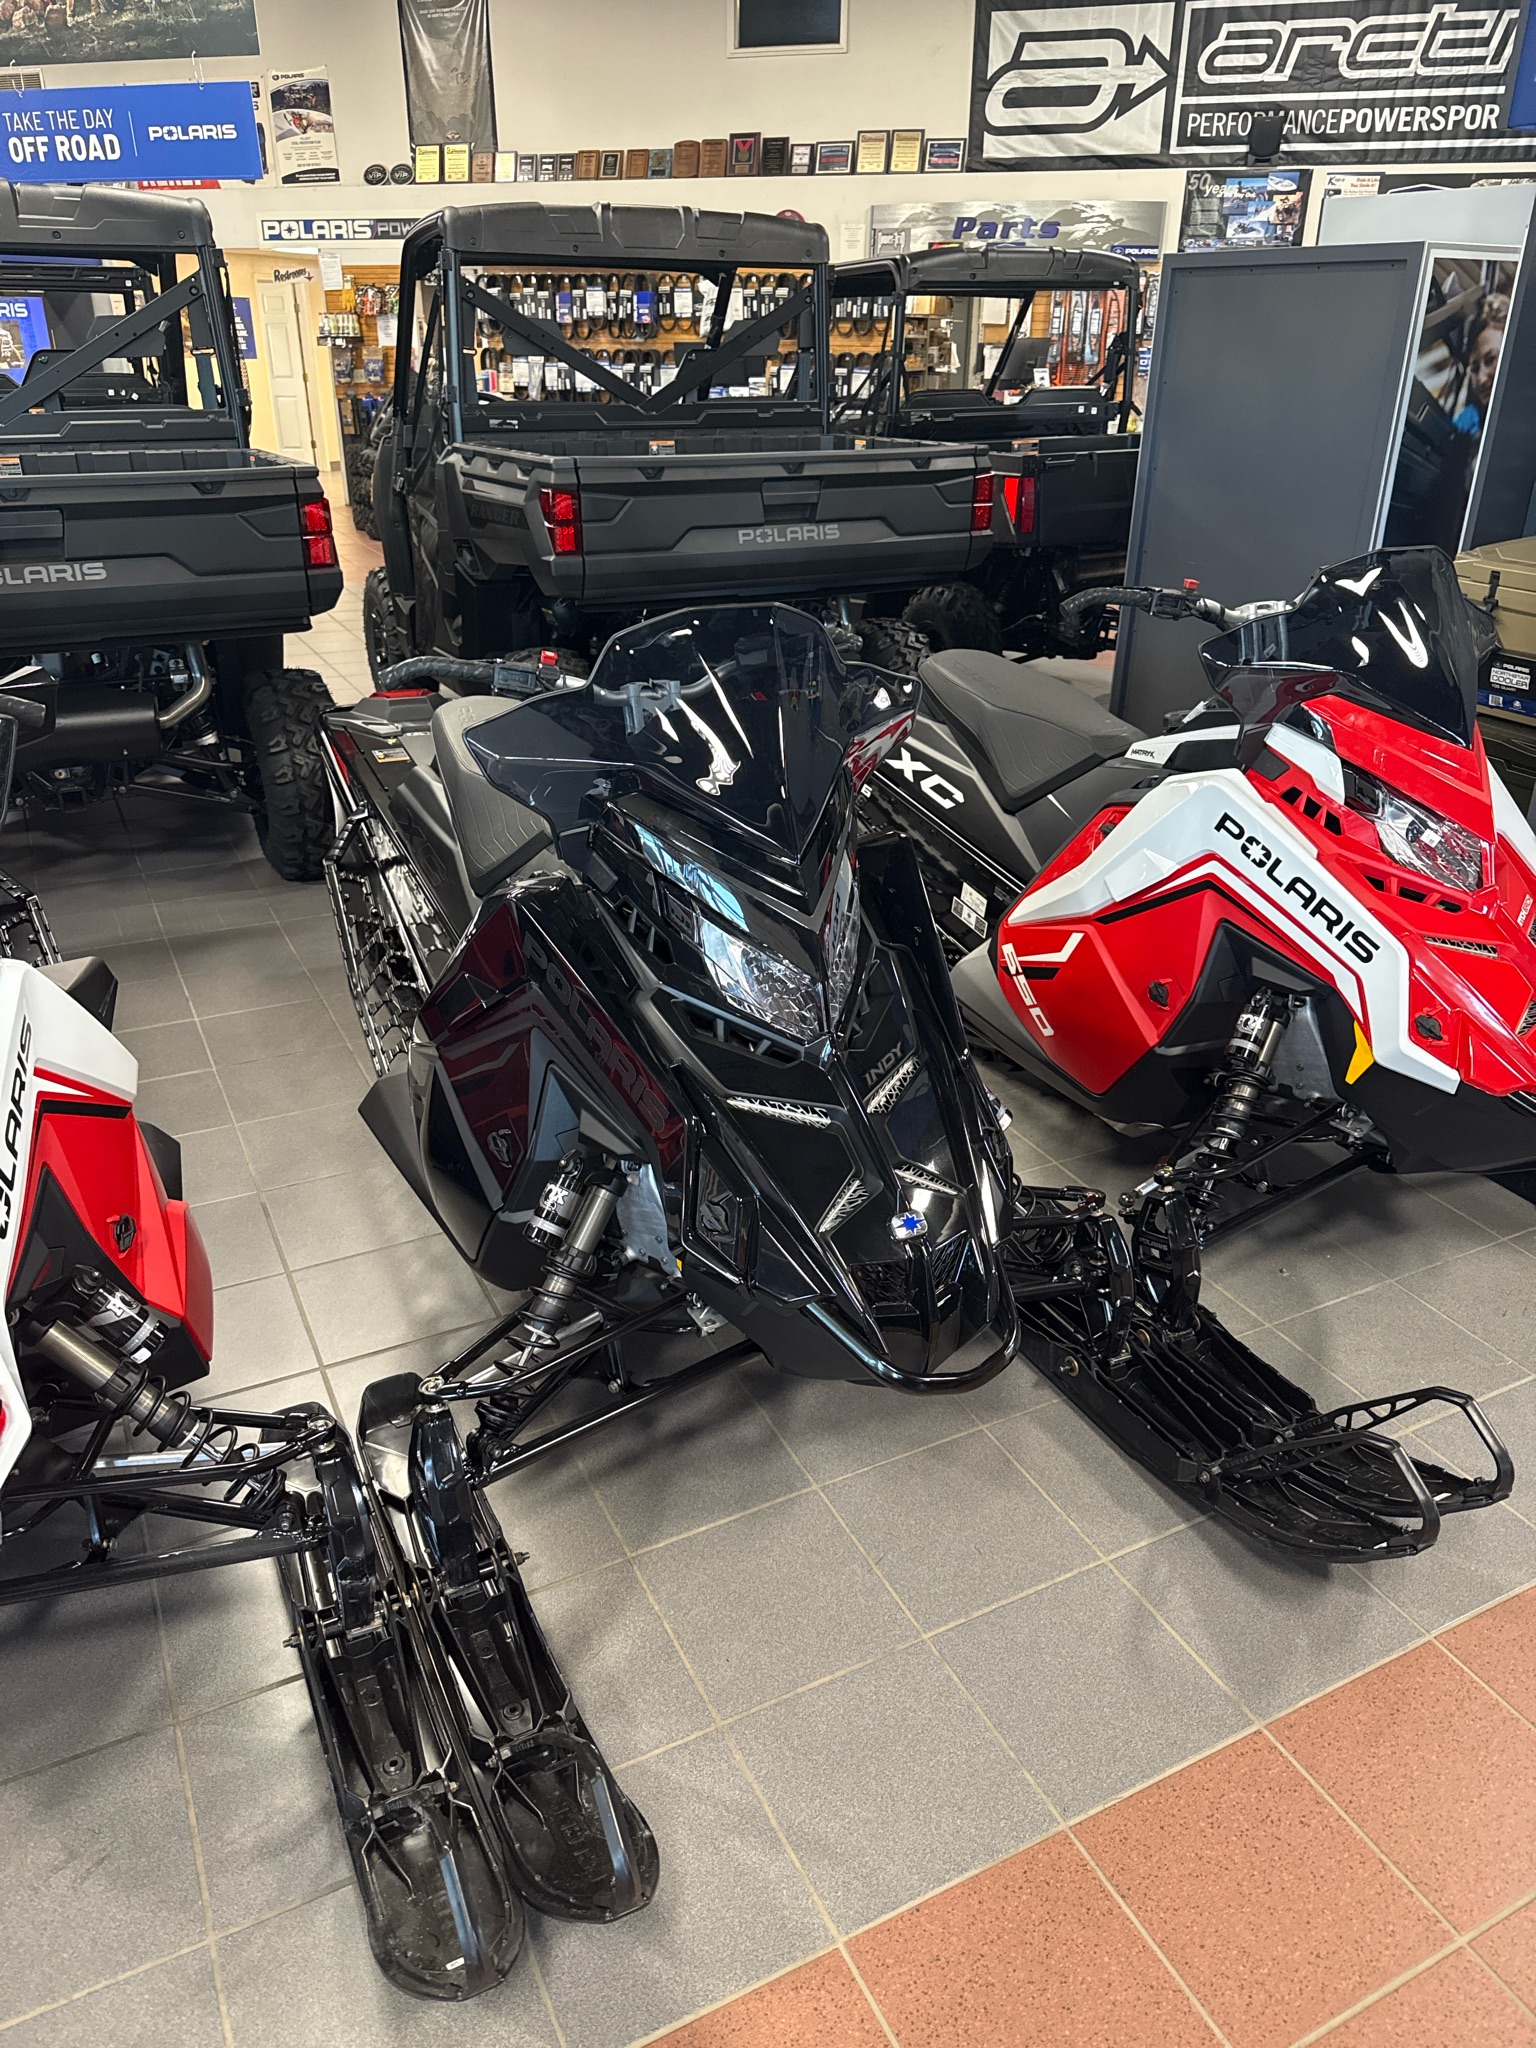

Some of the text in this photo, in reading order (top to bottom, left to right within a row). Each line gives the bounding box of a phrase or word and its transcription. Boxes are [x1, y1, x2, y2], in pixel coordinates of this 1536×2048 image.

[2, 108, 113, 132] TAKE THE DAY
[1187, 104, 1500, 137] PERFOANCEPOWERSPOR
[148, 124, 238, 141] POLARIS
[8, 133, 121, 163] OFF ROAD
[1188, 174, 1212, 190] 50
[1204, 184, 1240, 197] years
[262, 220, 372, 240] POLARIS
[953, 216, 1061, 239] Parts
[737, 523, 840, 545] POLARIS
[0, 562, 108, 586] LARIS
[1492, 669, 1530, 681] NORTHSTAR
[1502, 662, 1530, 674] POLARIS
[1491, 675, 1528, 688] COOLER
[1131, 748, 1155, 759] MATRYX
[885, 746, 966, 810] XC
[1214, 811, 1381, 964] POLARIS
[1000, 942, 1055, 1037] 650
[521, 931, 670, 1133] POLARIS
[865, 1041, 902, 1086] INDY
